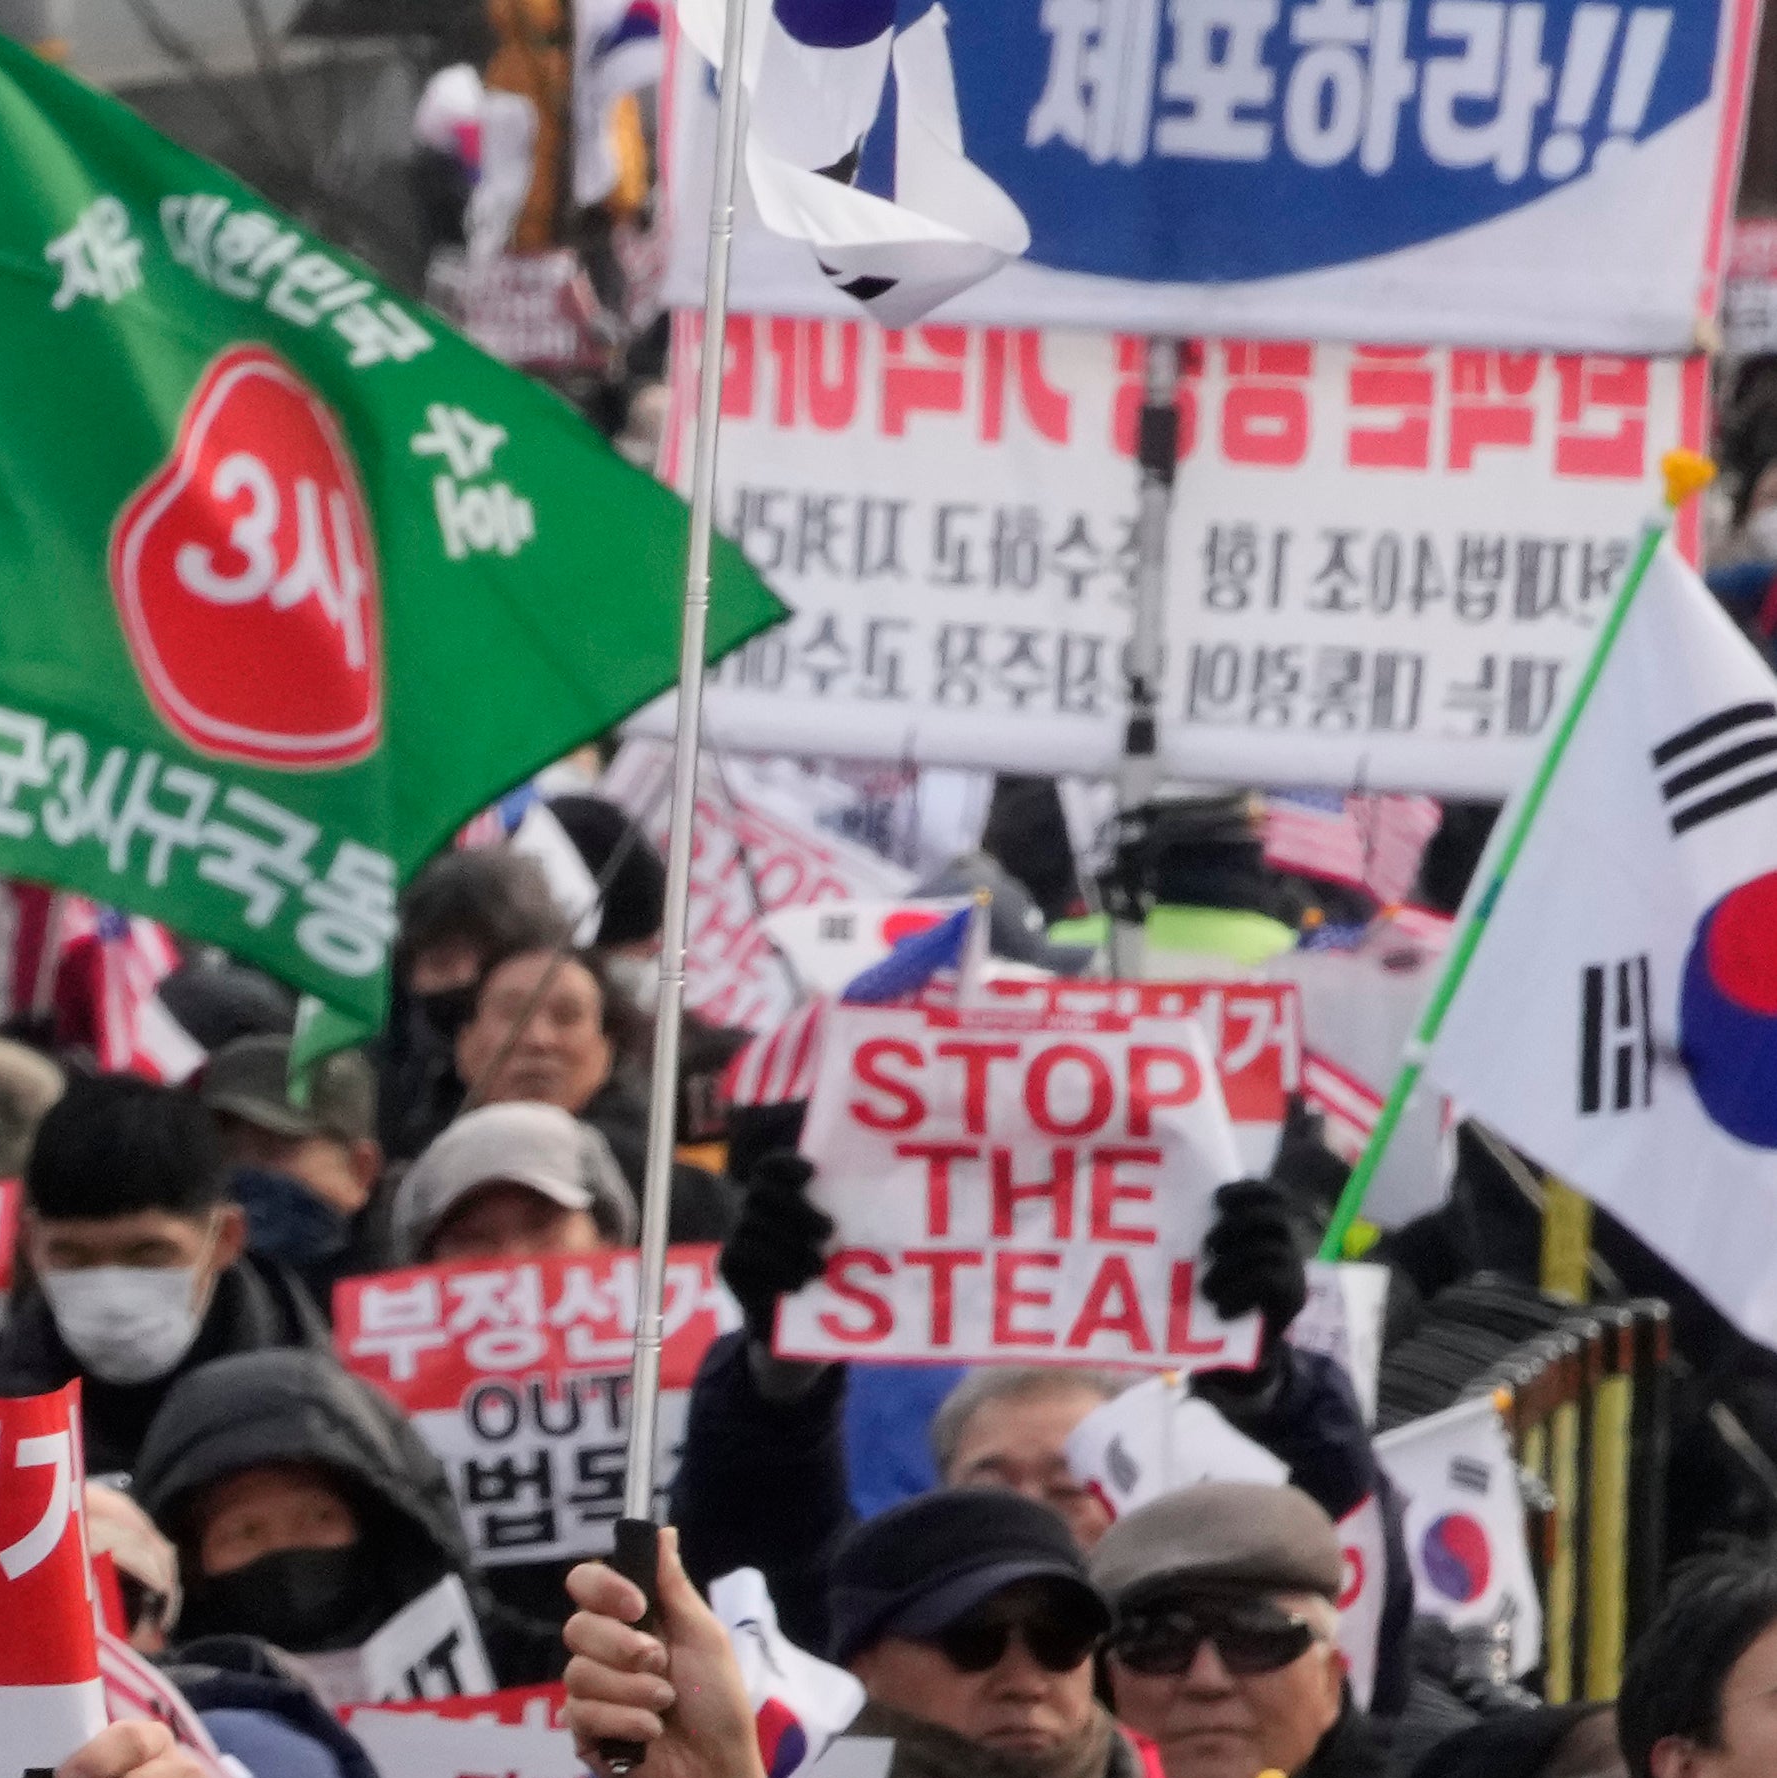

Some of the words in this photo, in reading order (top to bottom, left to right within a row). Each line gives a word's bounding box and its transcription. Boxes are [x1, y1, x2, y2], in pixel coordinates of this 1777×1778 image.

[1027, 0, 1673, 184] 체포하라!!
[174, 450, 366, 671] 3사
[850, 1038, 1203, 1137] STOP
[894, 1144, 1164, 1244] THE
[350, 1256, 745, 1382] 부정선거
[818, 1250, 1228, 1355] STEAL
[470, 1374, 632, 1440] OUT
